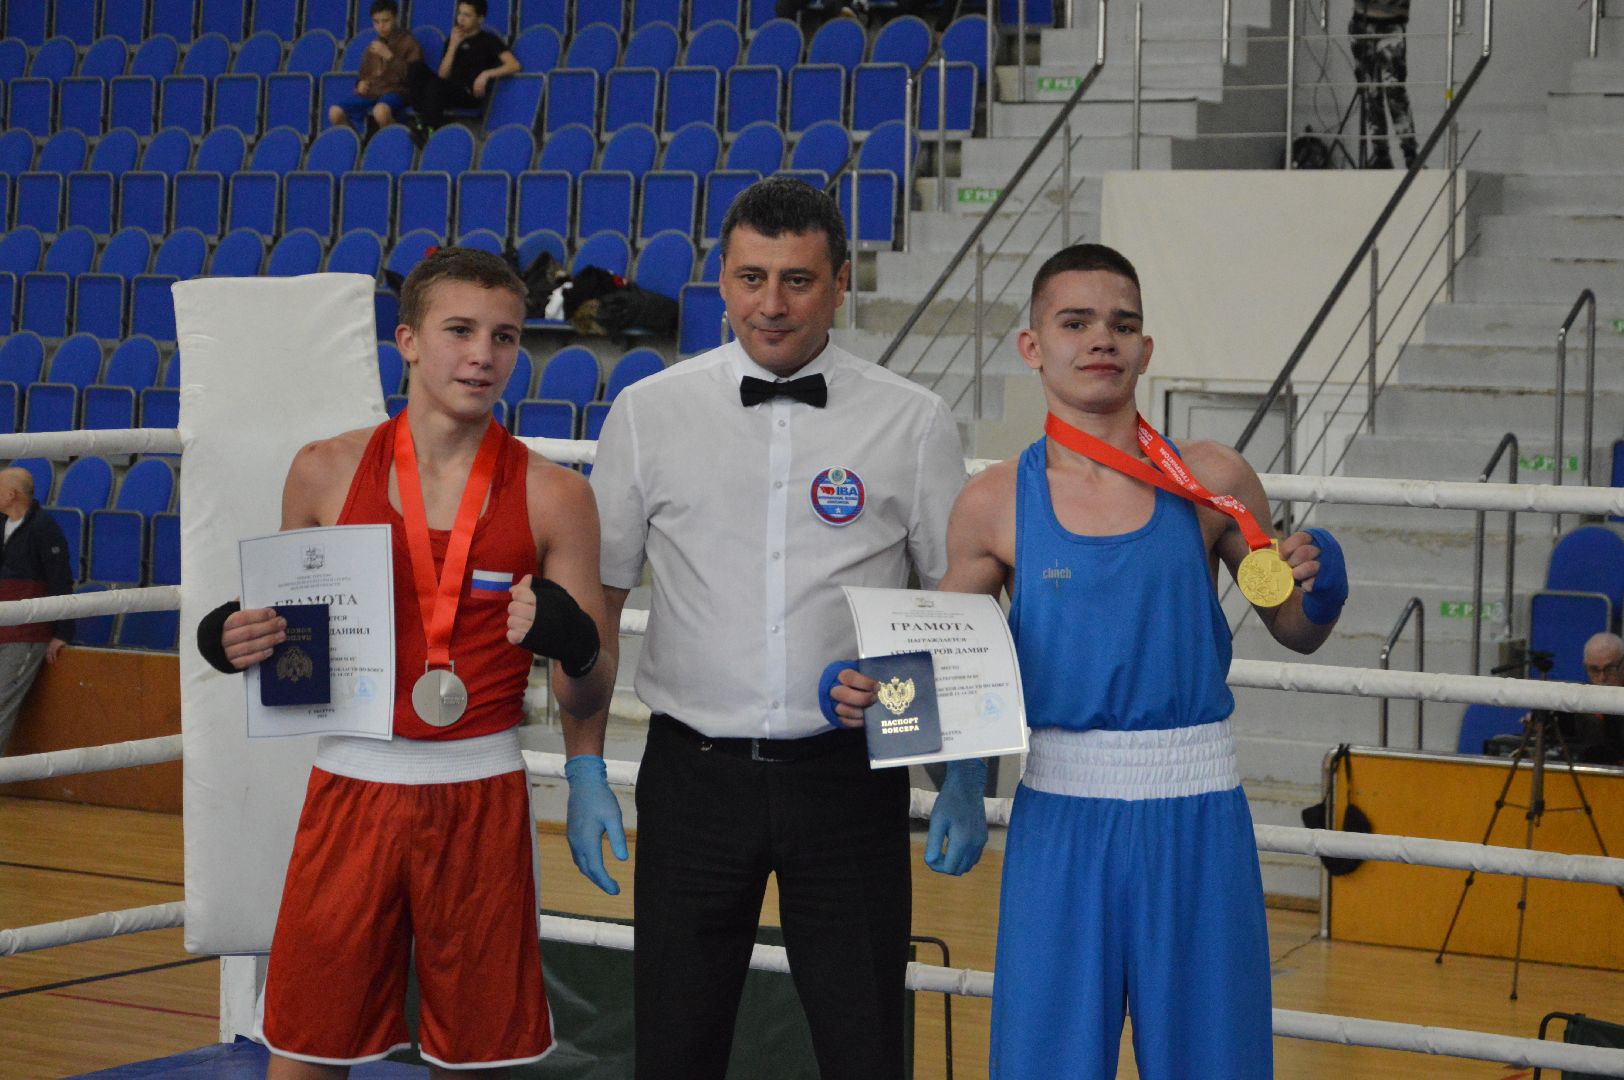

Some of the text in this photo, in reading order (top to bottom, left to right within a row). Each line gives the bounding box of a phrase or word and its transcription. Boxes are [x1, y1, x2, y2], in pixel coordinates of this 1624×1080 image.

[836, 486, 858, 496] IBA
[890, 622, 975, 631] ГРАМОТА
[330, 627, 370, 636] ДАНИИЛ
[955, 647, 989, 655] ДАМИР
[881, 717, 919, 727] ПАСПОРТ
[881, 725, 920, 734] БОКСЕРА
